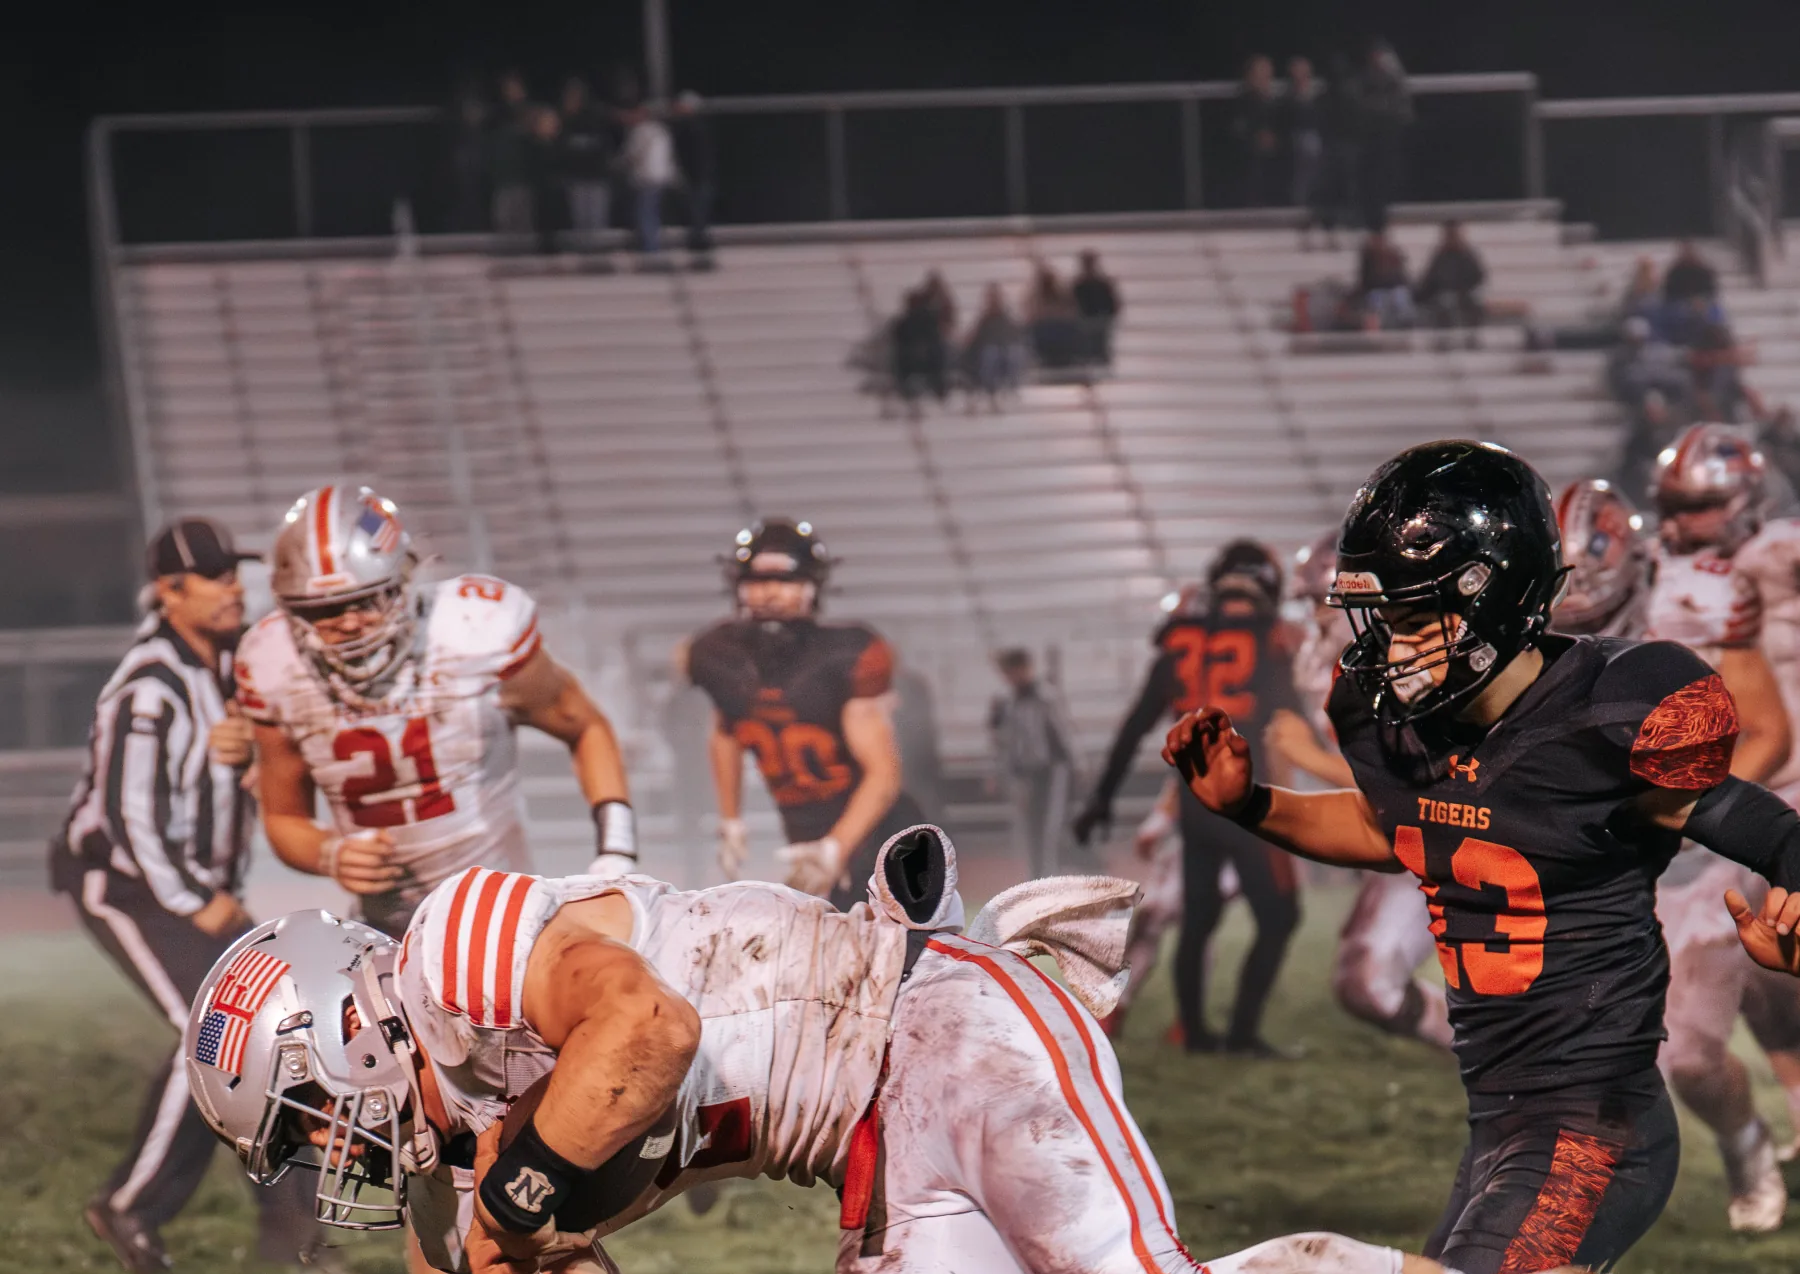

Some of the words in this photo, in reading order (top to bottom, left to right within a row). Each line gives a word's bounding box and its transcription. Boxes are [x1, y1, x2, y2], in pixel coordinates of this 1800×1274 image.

[333, 717, 456, 828] 21
[1418, 797, 1491, 830] TIGERS
[1394, 825, 1547, 996] 13
[211, 974, 255, 1024] F
